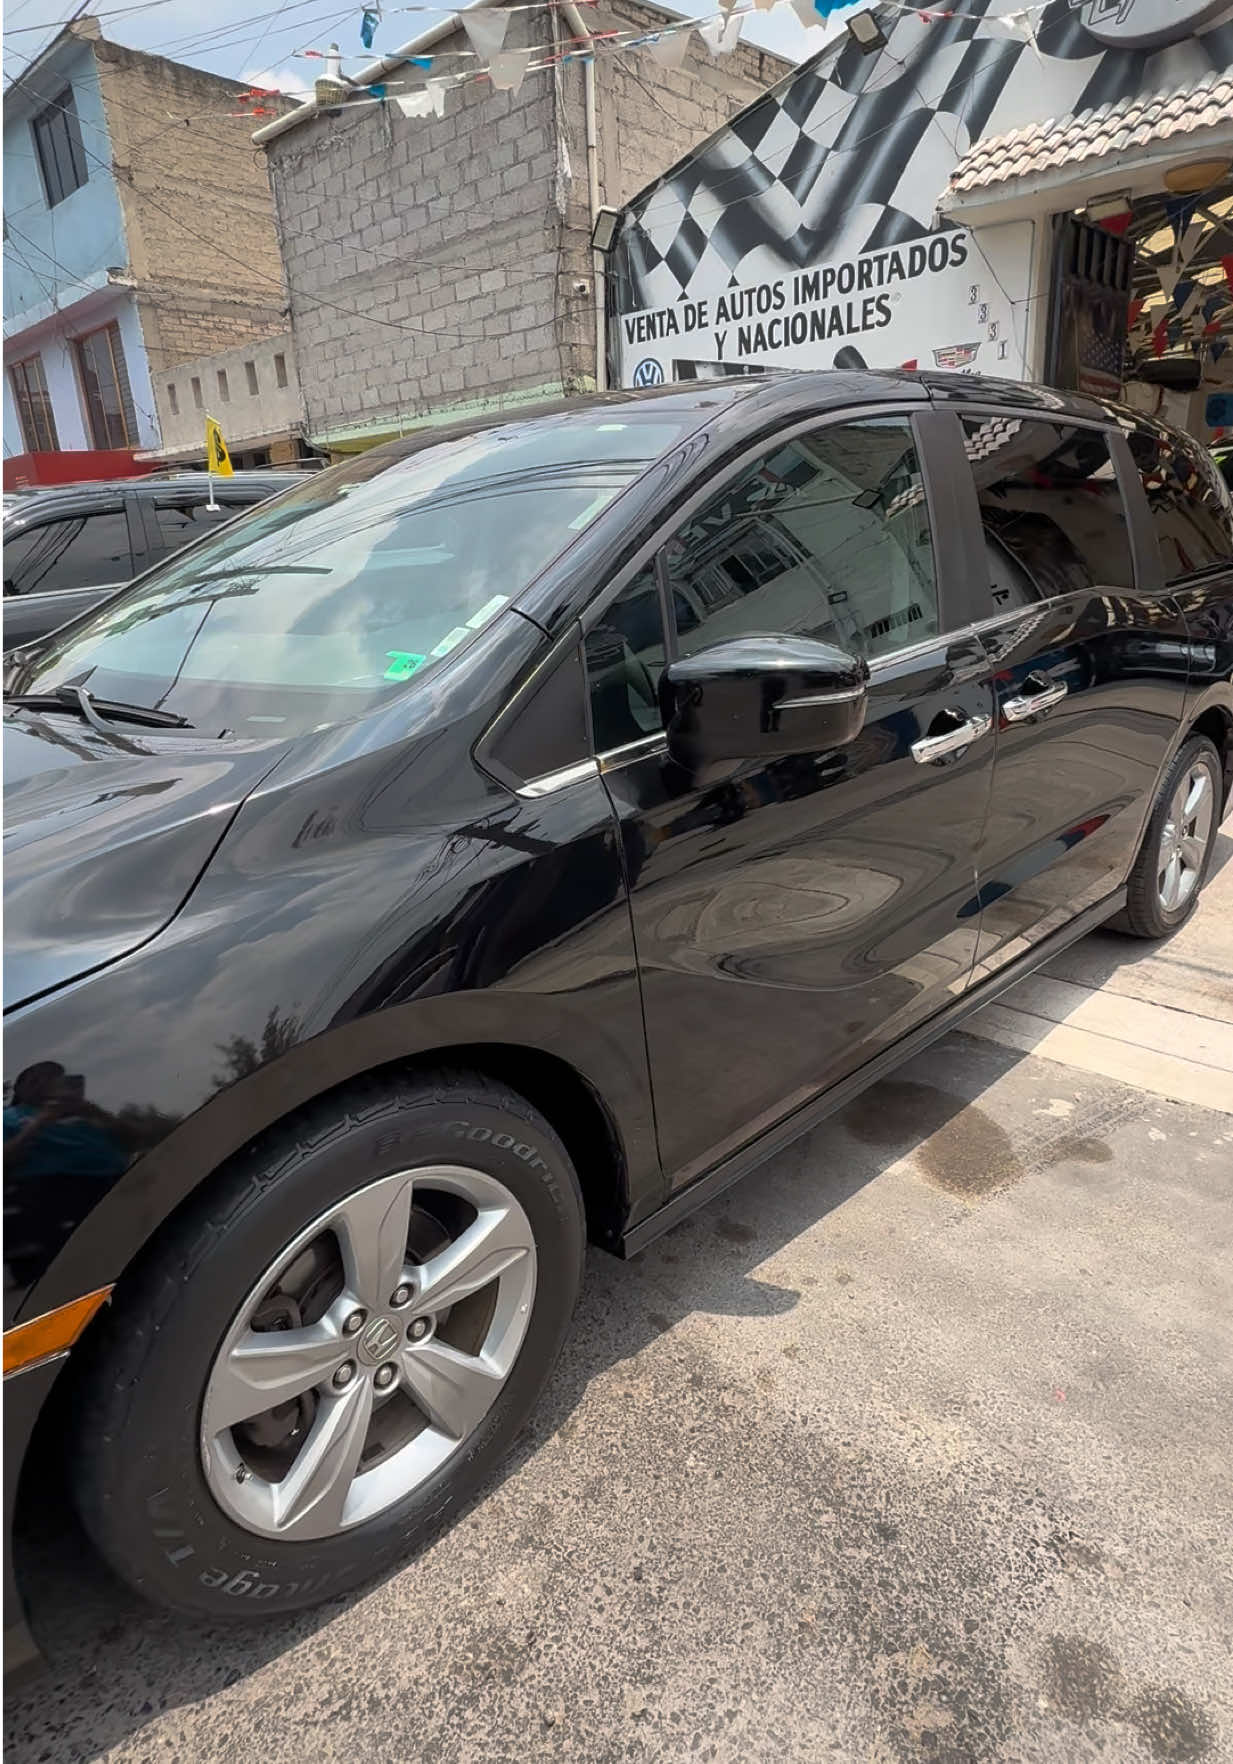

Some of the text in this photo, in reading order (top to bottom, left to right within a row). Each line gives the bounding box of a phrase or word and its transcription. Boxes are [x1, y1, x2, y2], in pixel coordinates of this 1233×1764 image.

[625, 233, 968, 344] VENTA DE AUTOS IMPORTADOS
[714, 293, 892, 361] Y NACIONALES
